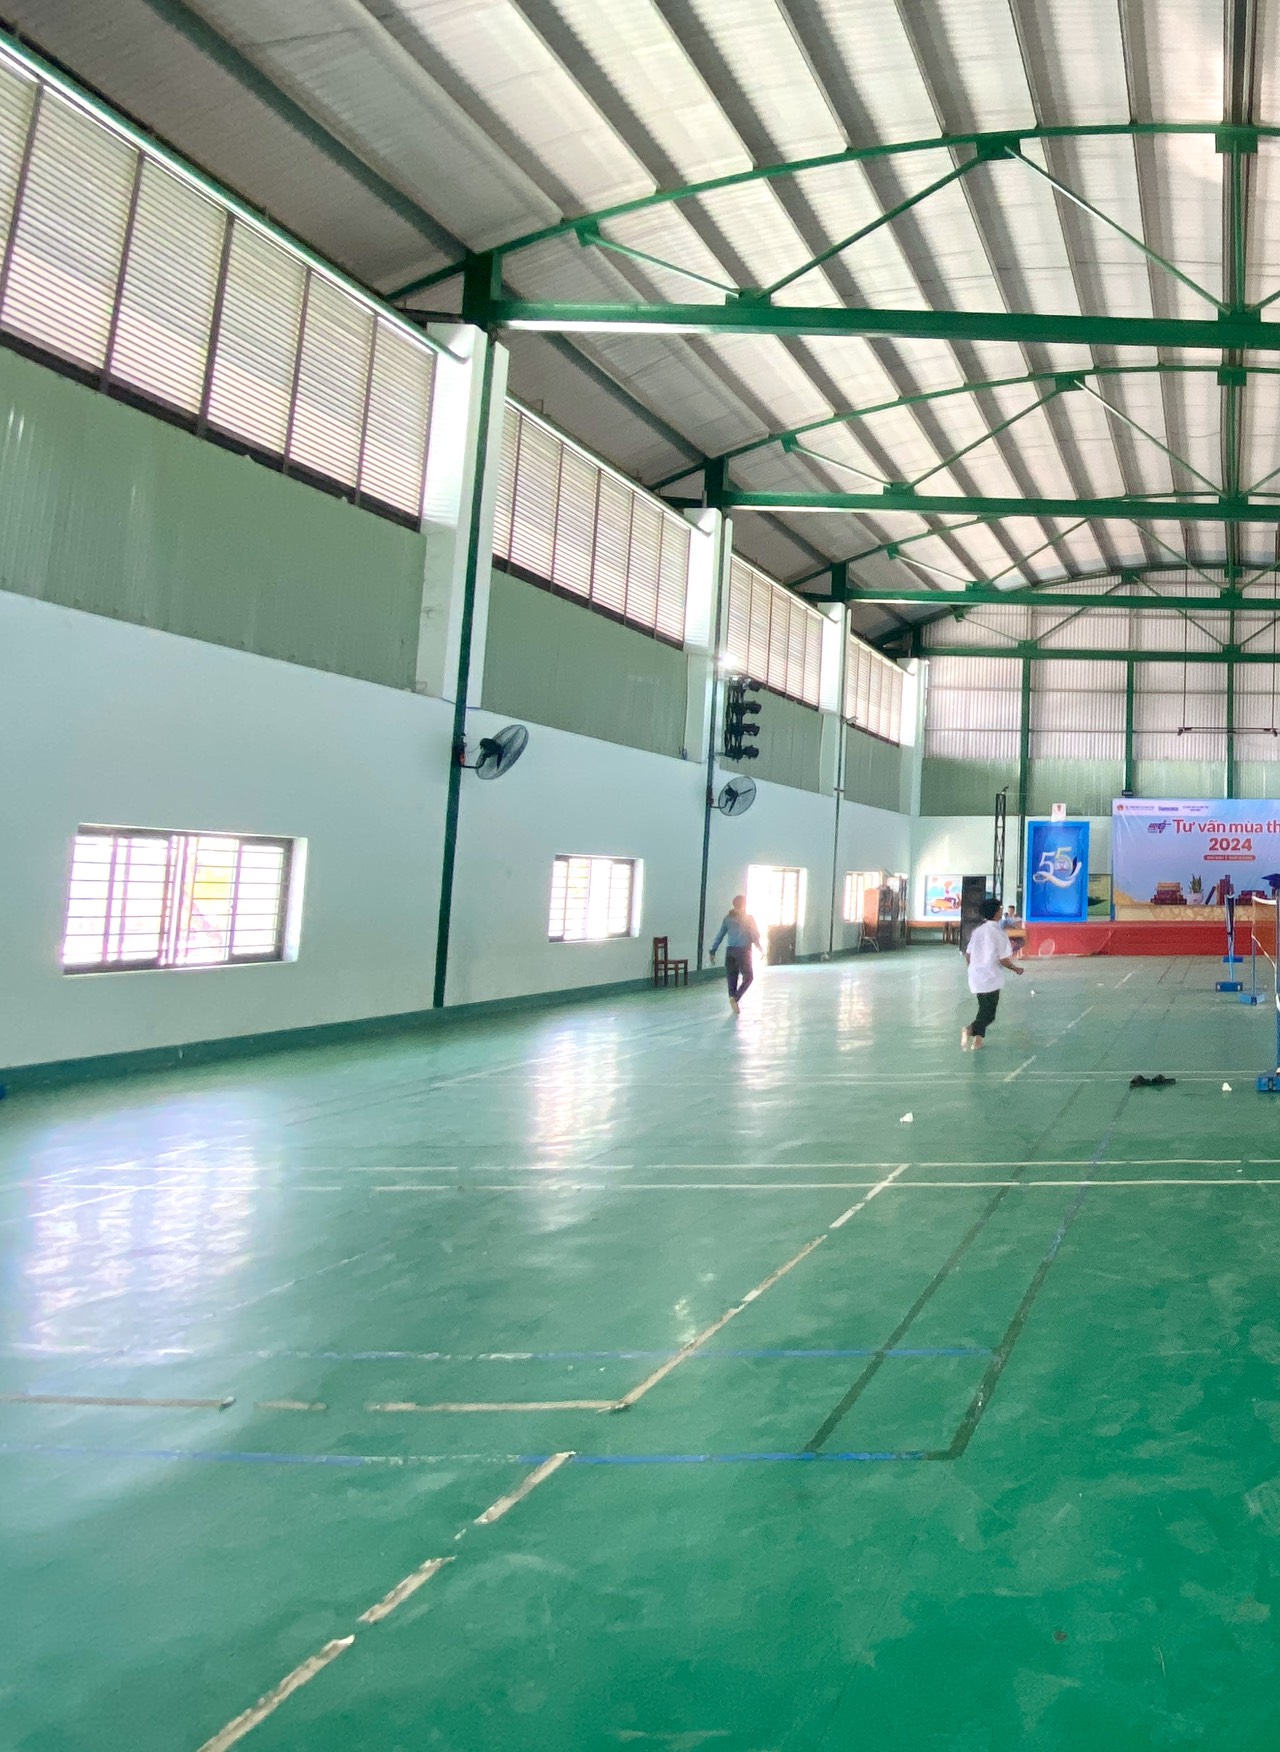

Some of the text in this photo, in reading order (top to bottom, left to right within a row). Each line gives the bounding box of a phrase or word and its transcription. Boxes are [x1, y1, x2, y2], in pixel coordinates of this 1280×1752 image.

[1172, 819, 1196, 835] Tư
[1198, 819, 1226, 833] vấn
[1229, 820, 1264, 833] mùa
[1208, 837, 1253, 851] 2024
